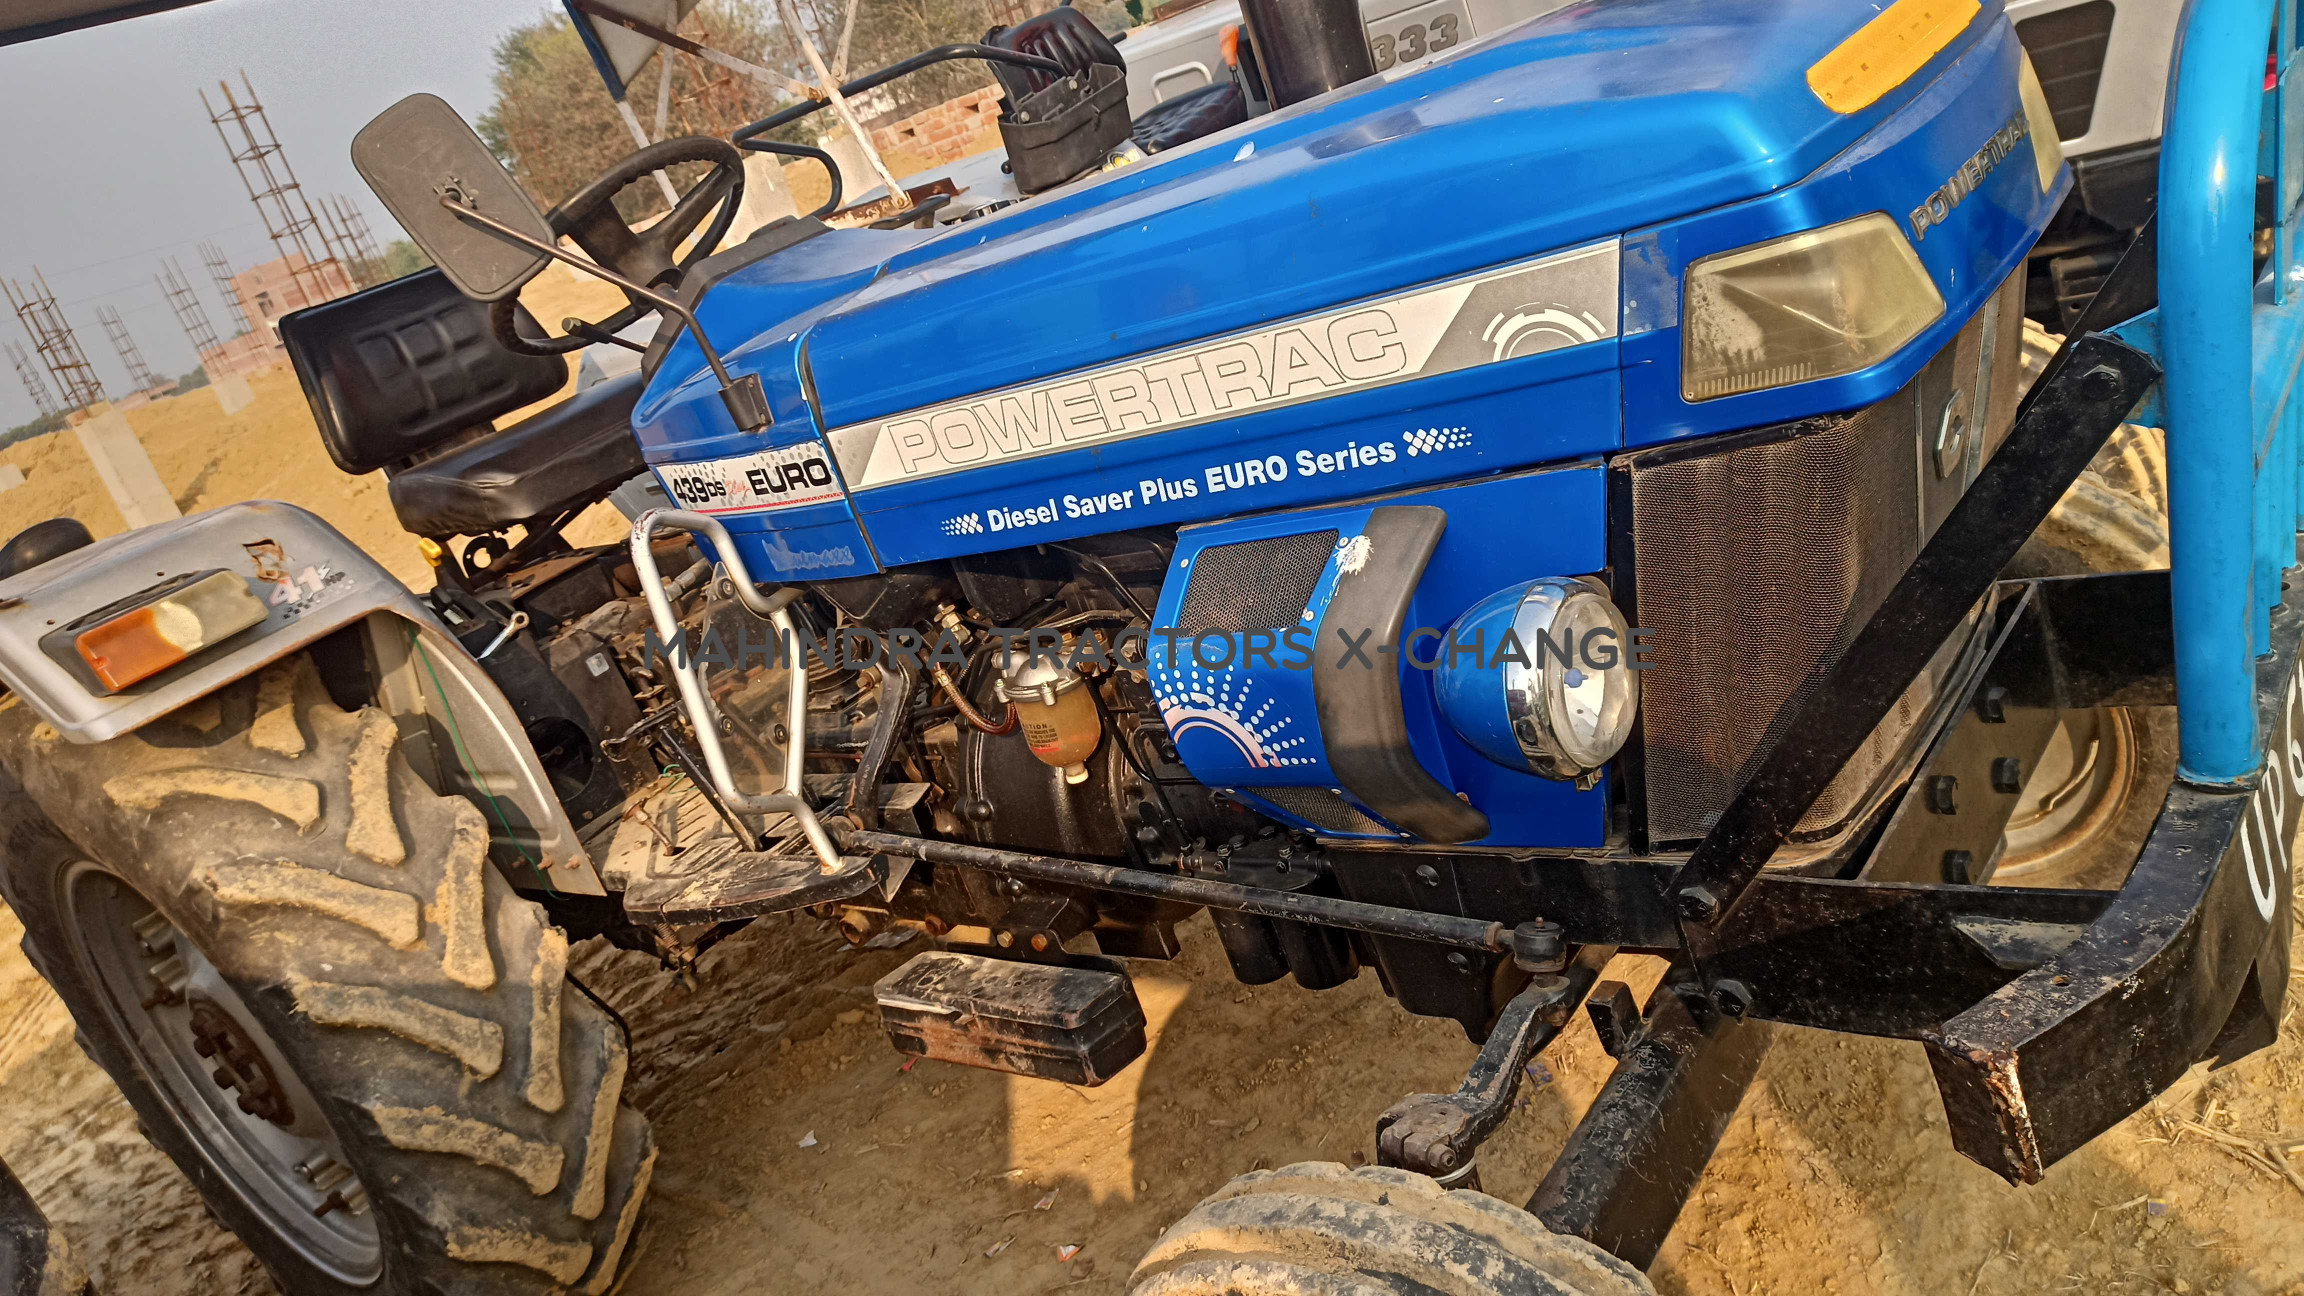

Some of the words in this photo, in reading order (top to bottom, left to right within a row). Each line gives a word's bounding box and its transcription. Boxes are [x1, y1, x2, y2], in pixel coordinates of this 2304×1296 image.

[1371, 13, 1459, 71] 333
[887, 309, 1408, 474] POWERTRAC
[745, 457, 833, 496] EURO
[986, 498, 1060, 533] Diesel
[1062, 488, 1134, 519] Saver
[1138, 477, 1199, 506] Plus
[1204, 455, 1289, 494] EURO
[1295, 441, 1397, 477] Series
